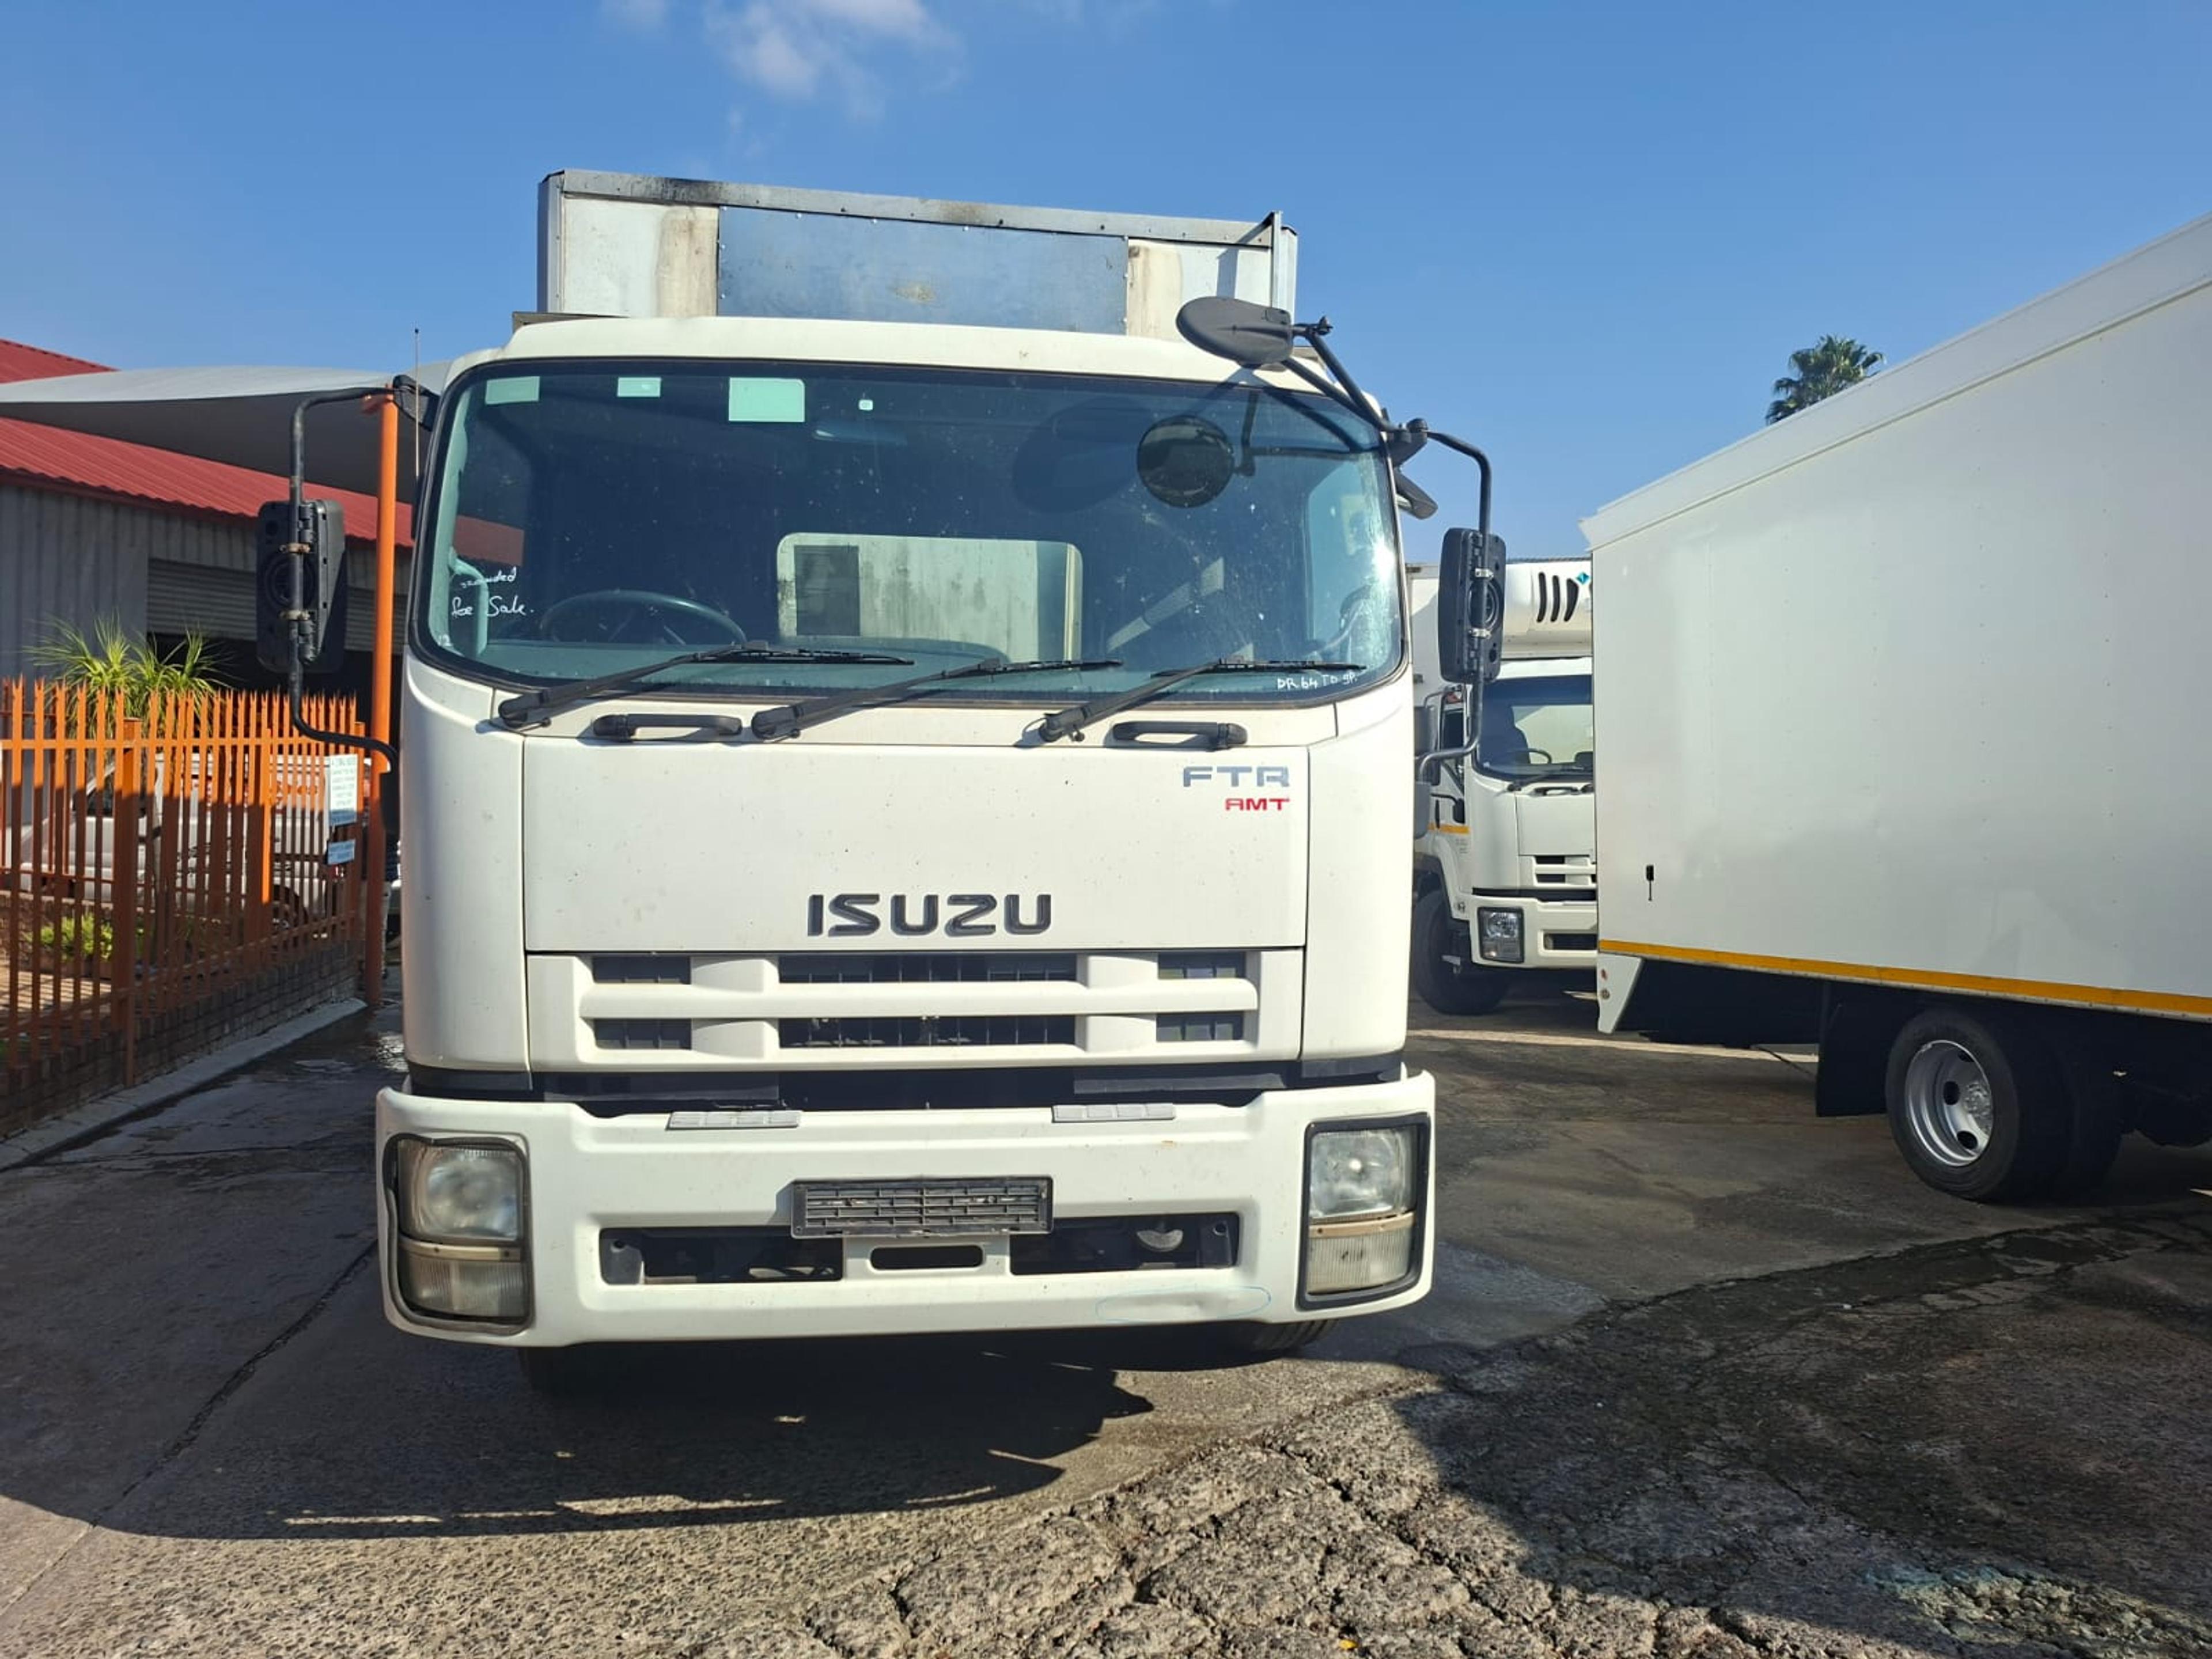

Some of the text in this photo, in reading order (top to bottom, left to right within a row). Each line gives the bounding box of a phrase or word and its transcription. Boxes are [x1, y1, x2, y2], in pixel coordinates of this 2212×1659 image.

[1277, 677, 1300, 690] DR
[1183, 766, 1290, 787] FTR
[1225, 798, 1290, 810] AMT
[808, 893, 1051, 937] ISUZU
